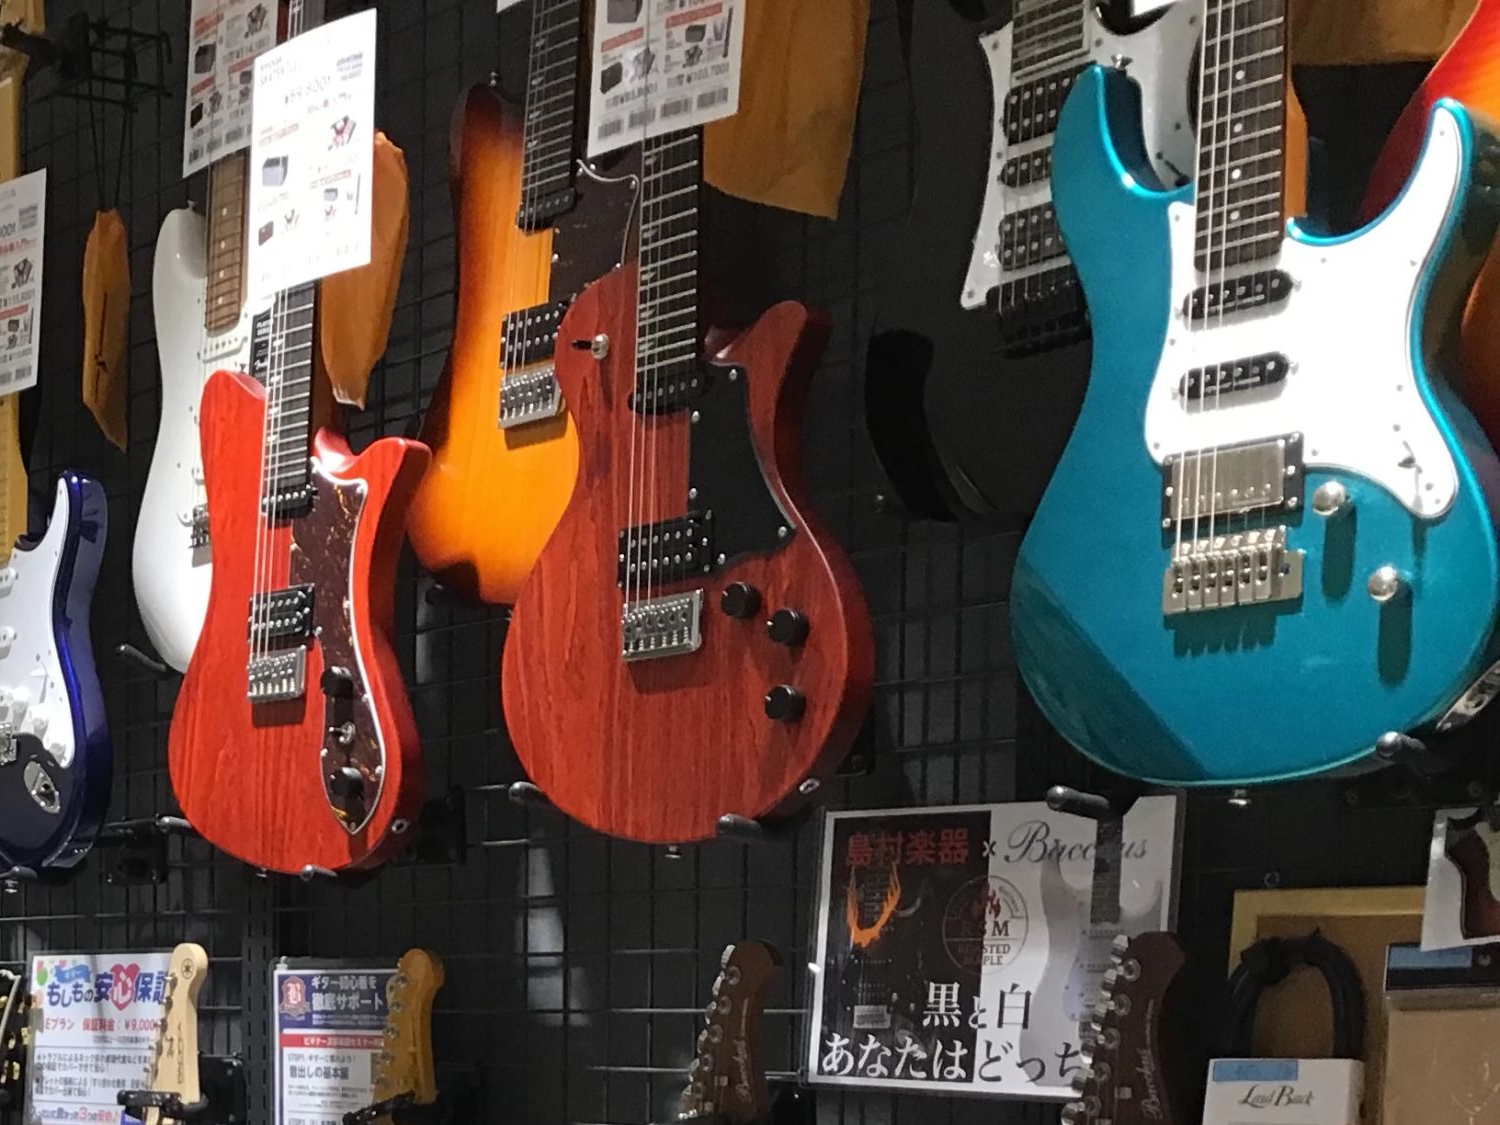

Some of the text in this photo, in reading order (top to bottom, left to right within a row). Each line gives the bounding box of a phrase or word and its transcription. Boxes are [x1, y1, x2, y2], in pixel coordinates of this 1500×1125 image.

[847, 828, 969, 866] 島村楽器
[1004, 820, 1148, 863] Baccus
[312, 992, 384, 1011] 徹底サポート
[923, 982, 1032, 1030] 黒と白
[821, 1032, 1083, 1083] あなたはどっち
